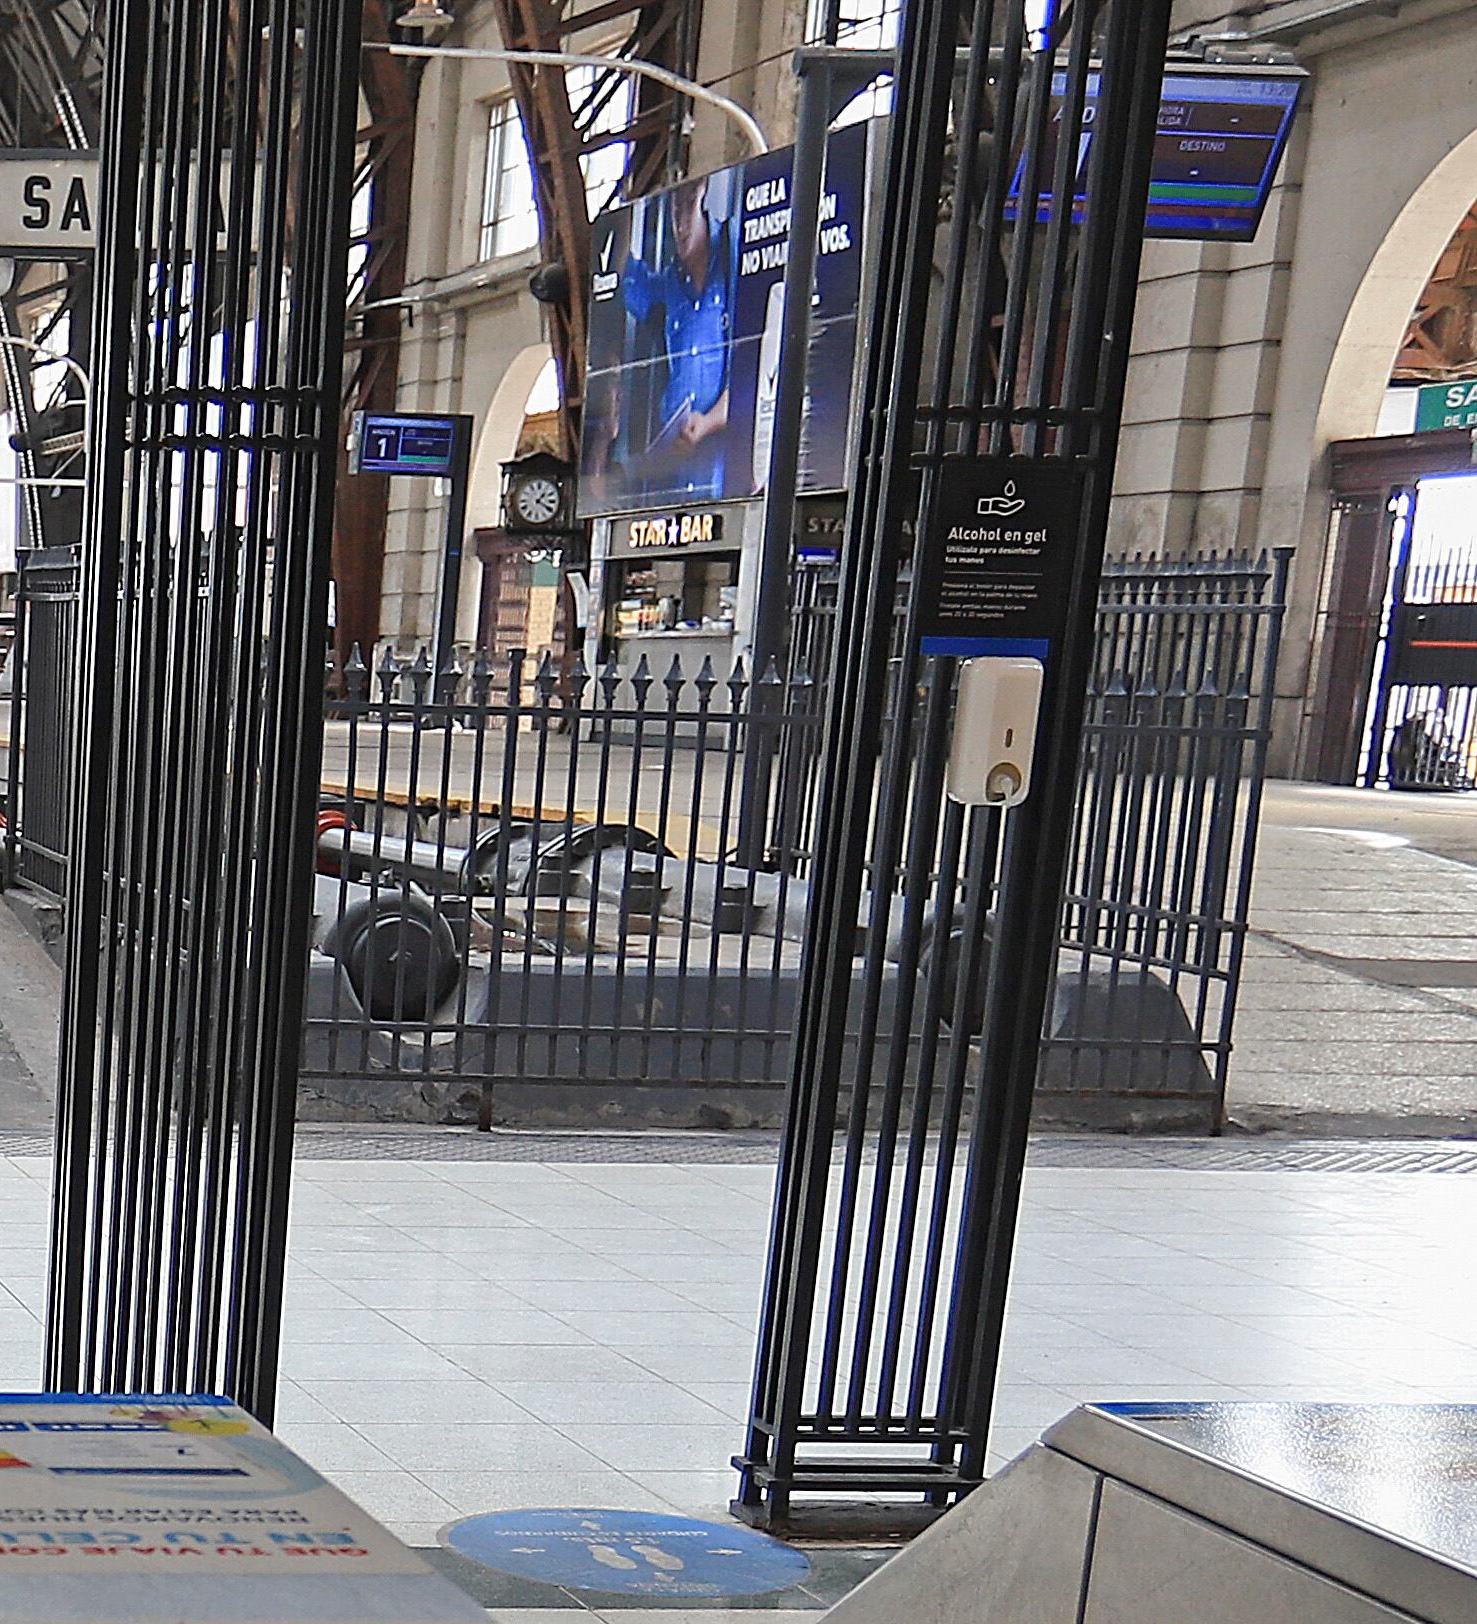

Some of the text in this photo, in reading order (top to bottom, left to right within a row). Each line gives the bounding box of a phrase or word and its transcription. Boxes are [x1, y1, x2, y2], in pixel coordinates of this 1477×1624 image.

[1178, 140, 1226, 152] DESTINO
[745, 177, 786, 212] QUE LA
[741, 249, 760, 276] NO
[820, 224, 851, 255] VOS.
[378, 438, 387, 458] 1
[629, 514, 713, 549] STAR BAR
[947, 527, 1047, 545] Alcohol en gel
[165, 1532, 249, 1544] TU
[268, 1532, 356, 1544] EN
[81, 1547, 206, 1556] VIAJE
[217, 1547, 271, 1556] TU
[281, 1547, 369, 1557] QUE
